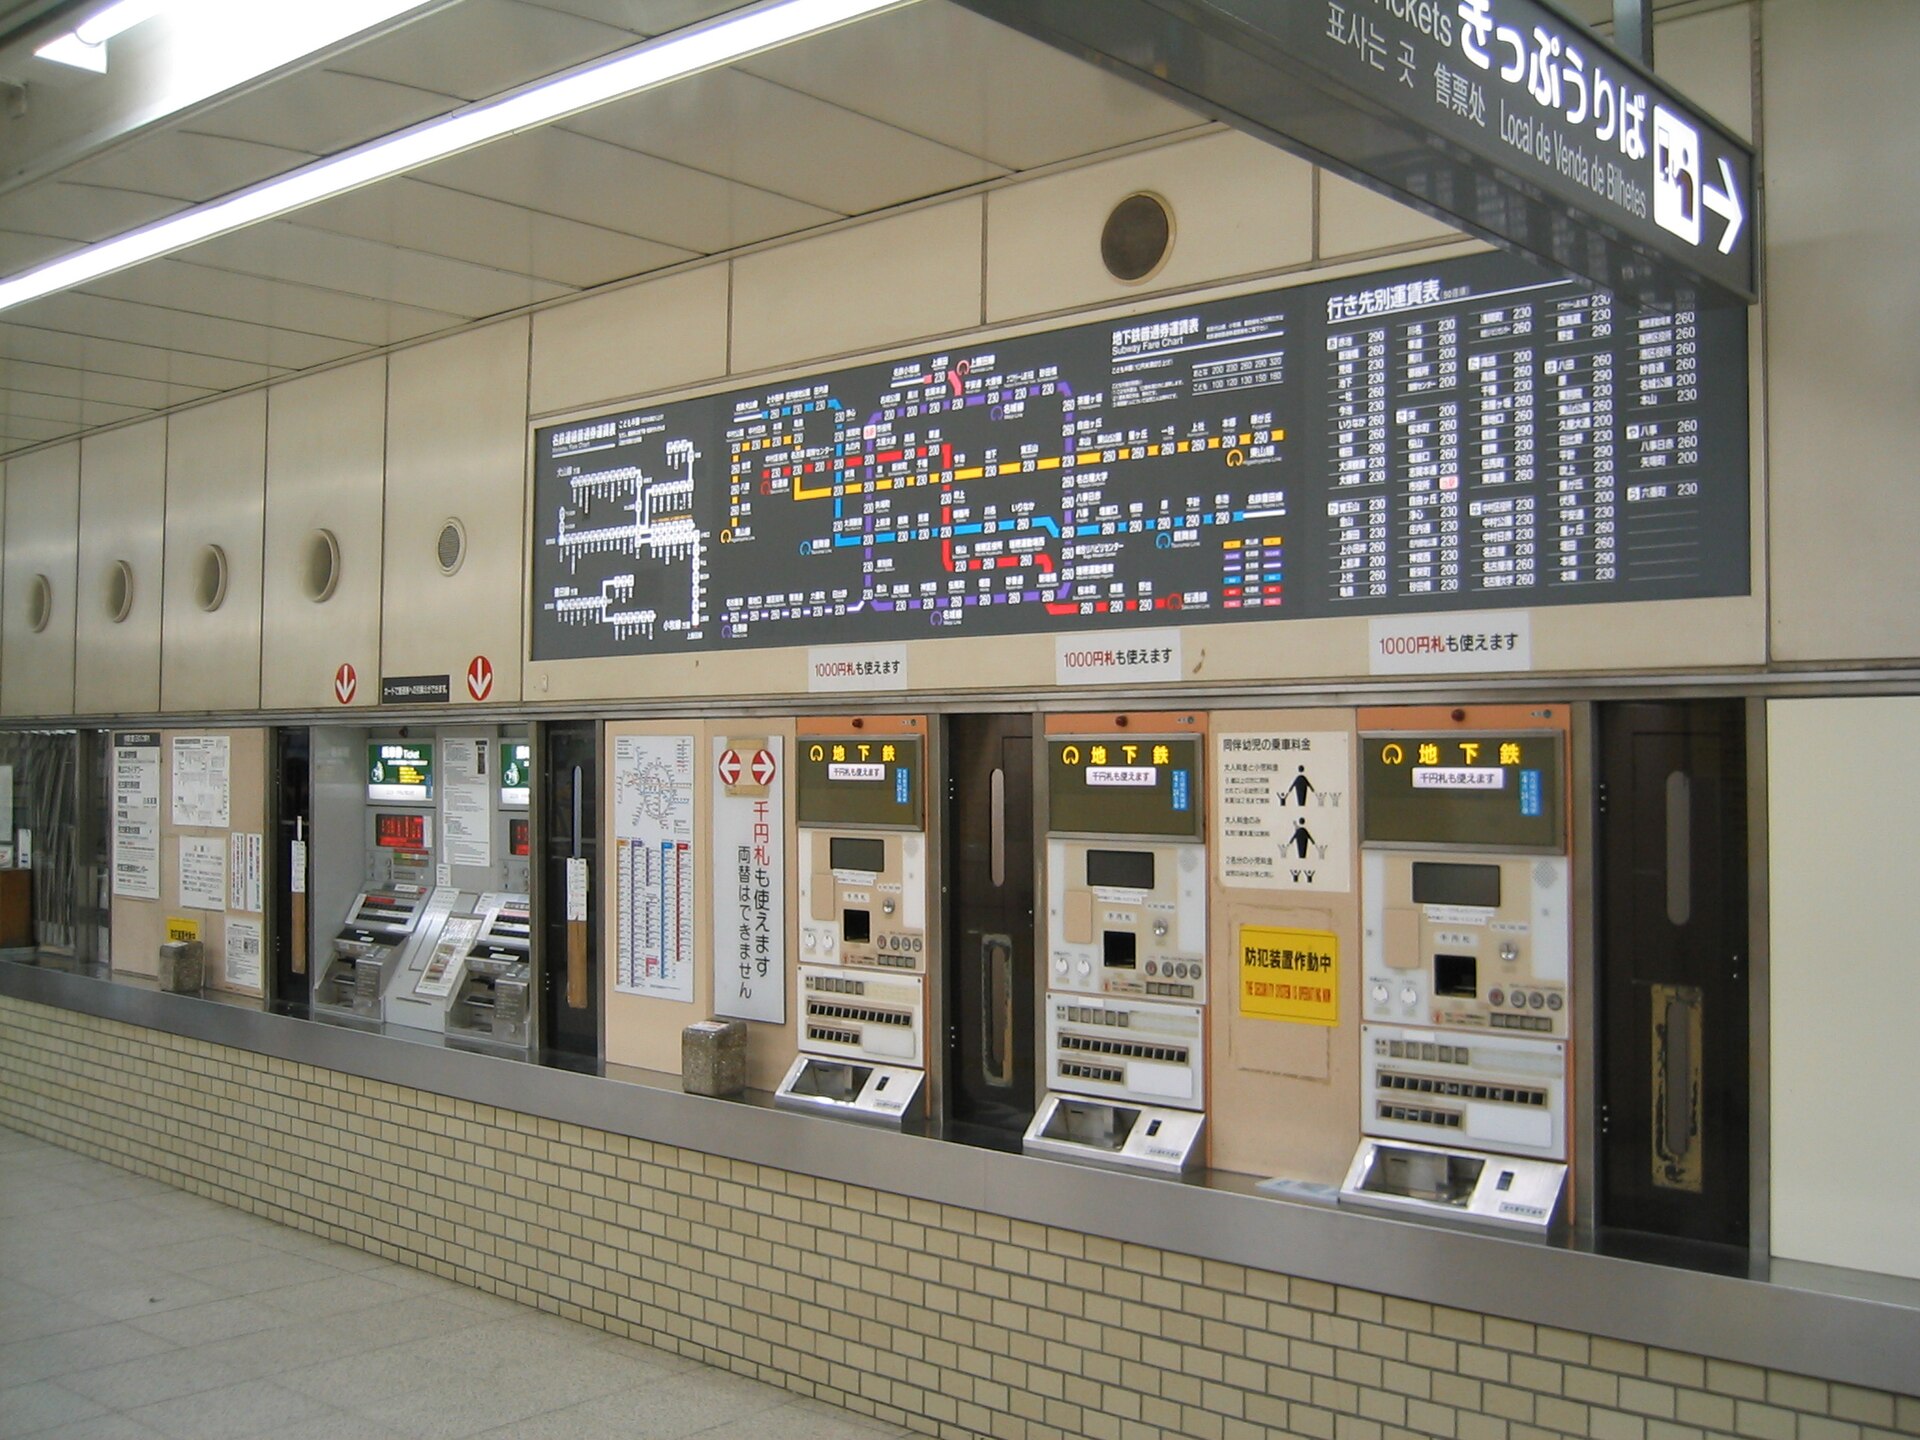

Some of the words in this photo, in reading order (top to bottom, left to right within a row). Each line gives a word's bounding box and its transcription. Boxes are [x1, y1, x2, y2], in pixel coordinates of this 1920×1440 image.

[1373, 0, 1453, 47] ickets
[1326, 2, 1387, 72] 표사는
[1397, 40, 1416, 88] 곳
[1457, 0, 1646, 160] きっぷうりば
[1433, 62, 1486, 128] 售票处
[1500, 98, 1533, 156] Local
[1536, 122, 1551, 165] de
[1553, 129, 1589, 187] Venda
[1591, 155, 1604, 196] de
[1606, 162, 1647, 219] Bilhetes
[1326, 279, 1439, 319] 行き先別運賃表
[1513, 306, 1531, 320] 230
[1592, 308, 1611, 322] 230
[1675, 311, 1695, 325] 260
[1438, 318, 1456, 331] 230
[1592, 323, 1611, 337] 290
[1368, 330, 1385, 343] 290
[1112, 343, 1141, 356] Subway
[1142, 339, 1160, 351] Fare
[1162, 336, 1184, 348] Chart
[1675, 341, 1695, 355] 260
[1438, 347, 1456, 359] 200
[1513, 350, 1532, 364] 200
[1368, 358, 1385, 371] 230
[1593, 353, 1611, 367] 260
[1676, 357, 1695, 370] 260
[1439, 361, 1456, 374] 230
[1513, 365, 1532, 378] 260
[1368, 372, 1385, 385] 230
[1676, 373, 1696, 386] 200
[1368, 385, 1385, 398] 260
[1593, 384, 1612, 397] 230
[1676, 388, 1696, 402] 230
[1514, 395, 1532, 408] 260
[1593, 399, 1612, 412] 260
[1439, 404, 1456, 417] 200
[1514, 410, 1532, 423] 260
[1339, 417, 1366, 429] いりなか
[1369, 414, 1385, 427] 260
[1439, 419, 1457, 432] 260
[1593, 414, 1612, 427] 200
[1677, 420, 1697, 433] 260
[1369, 428, 1385, 441] 260
[1593, 429, 1613, 442] 230
[1369, 441, 1385, 454] 290
[1514, 439, 1533, 452] 230
[1677, 436, 1697, 449] 260
[1439, 447, 1457, 460] 260
[1514, 453, 1533, 467] 260
[1677, 451, 1697, 464] 200
[1439, 462, 1457, 474] 230
[1594, 459, 1613, 472] 230
[1369, 469, 1386, 482] 230
[1594, 474, 1613, 488] 290
[1678, 482, 1698, 496] 230
[1440, 491, 1457, 504] 260
[1594, 489, 1614, 503] 200
[1369, 498, 1386, 511] 230
[1515, 498, 1533, 511] 230
[1440, 506, 1457, 519] 230
[1594, 505, 1614, 518] 230
[1515, 513, 1533, 526] 230
[1369, 526, 1386, 539] 230
[1515, 527, 1534, 540] 230
[1595, 521, 1614, 534] 260
[1370, 540, 1386, 553] 260
[1440, 535, 1458, 547] 230
[1515, 542, 1534, 555] 230
[1440, 549, 1458, 562] 230
[1595, 552, 1615, 565] 290
[1516, 557, 1534, 571] 260
[1370, 569, 1386, 582] 260
[1516, 573, 1534, 586] 260
[1595, 567, 1615, 581] 230
[1370, 583, 1386, 596] 230
[1440, 578, 1458, 590] 230
[1380, 632, 1519, 655] 1000円札も使えます
[1063, 647, 1172, 669] 1000円札も使えます
[815, 660, 900, 677] 1000円札も使えます
[1223, 737, 1311, 752] 同伴幼児の乗車料金
[832, 744, 896, 763] 地下鉄
[1090, 745, 1170, 765] 地下鉄
[1419, 742, 1520, 765] 地下鉄
[1419, 771, 1495, 785] 千円札も使えます
[752, 801, 770, 977] 千円札も使えます
[737, 845, 751, 999] 両替はできません
[1245, 947, 1331, 973] 防犯装置作動中
